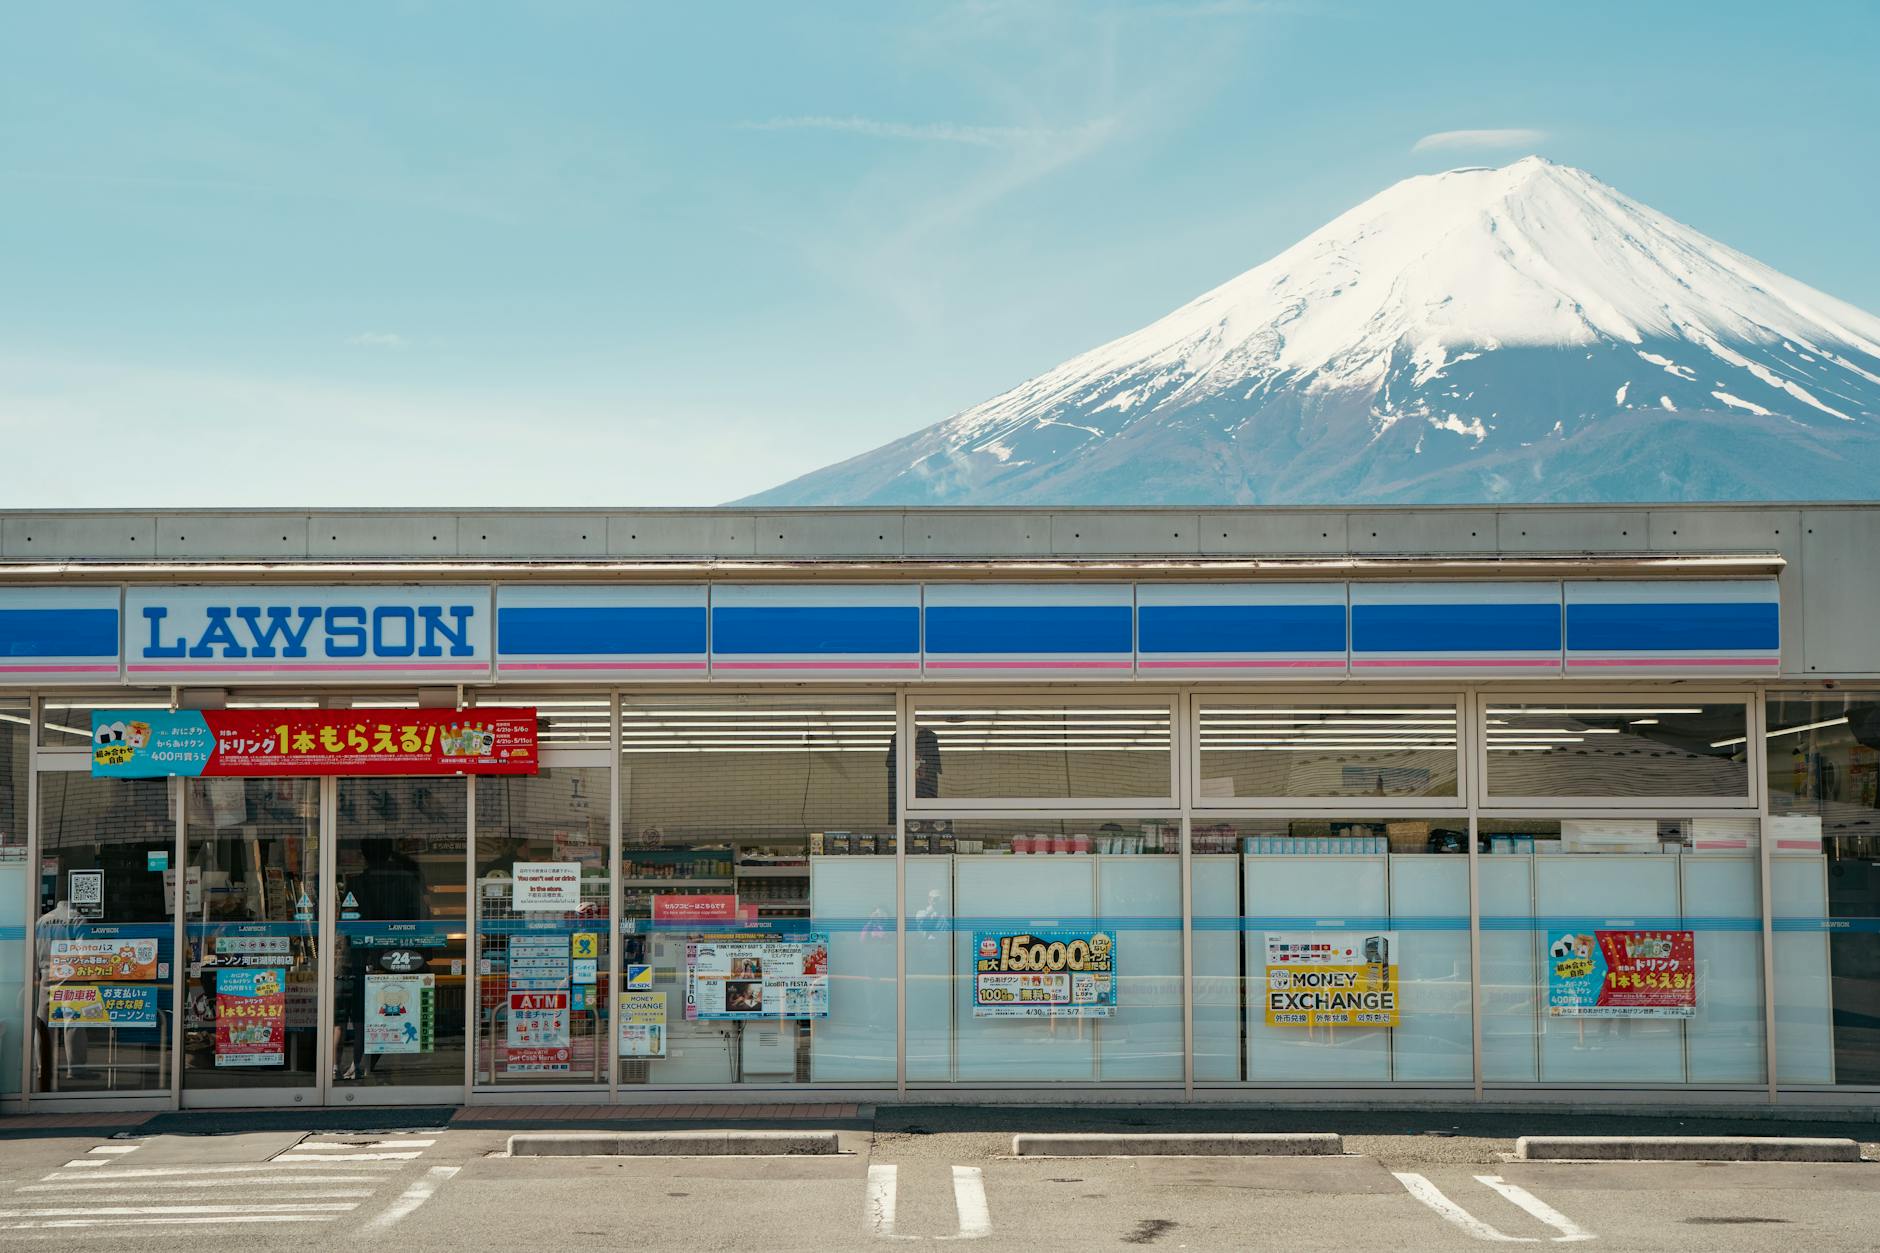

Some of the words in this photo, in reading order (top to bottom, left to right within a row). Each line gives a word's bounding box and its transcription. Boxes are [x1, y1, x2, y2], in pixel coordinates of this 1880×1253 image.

[143, 606, 474, 658] LAWSON
[274, 724, 436, 754] 1本もらえる!
[219, 738, 275, 754] ドリンク
[96, 747, 134, 758] 組み合わせ
[151, 751, 206, 761] 400円買うと
[109, 756, 124, 764] 自由
[391, 952, 411, 964] 24
[977, 960, 998, 971] 最大
[1557, 959, 1594, 971] 組み合わせ
[1635, 959, 1680, 971] ドリンク
[1570, 969, 1584, 977] 自由
[1293, 973, 1357, 987] MONEY
[1608, 973, 1693, 988] 1本もらえる!
[54, 990, 96, 1001] 自動車税
[103, 989, 147, 998] お支払いは
[105, 1000, 151, 1010] 好きな時に
[520, 996, 558, 1008] ATM
[1271, 992, 1393, 1010] EXCHANGE
[219, 1005, 283, 1018] 1本もらえる!
[1025, 1008, 1042, 1016] 4/30
